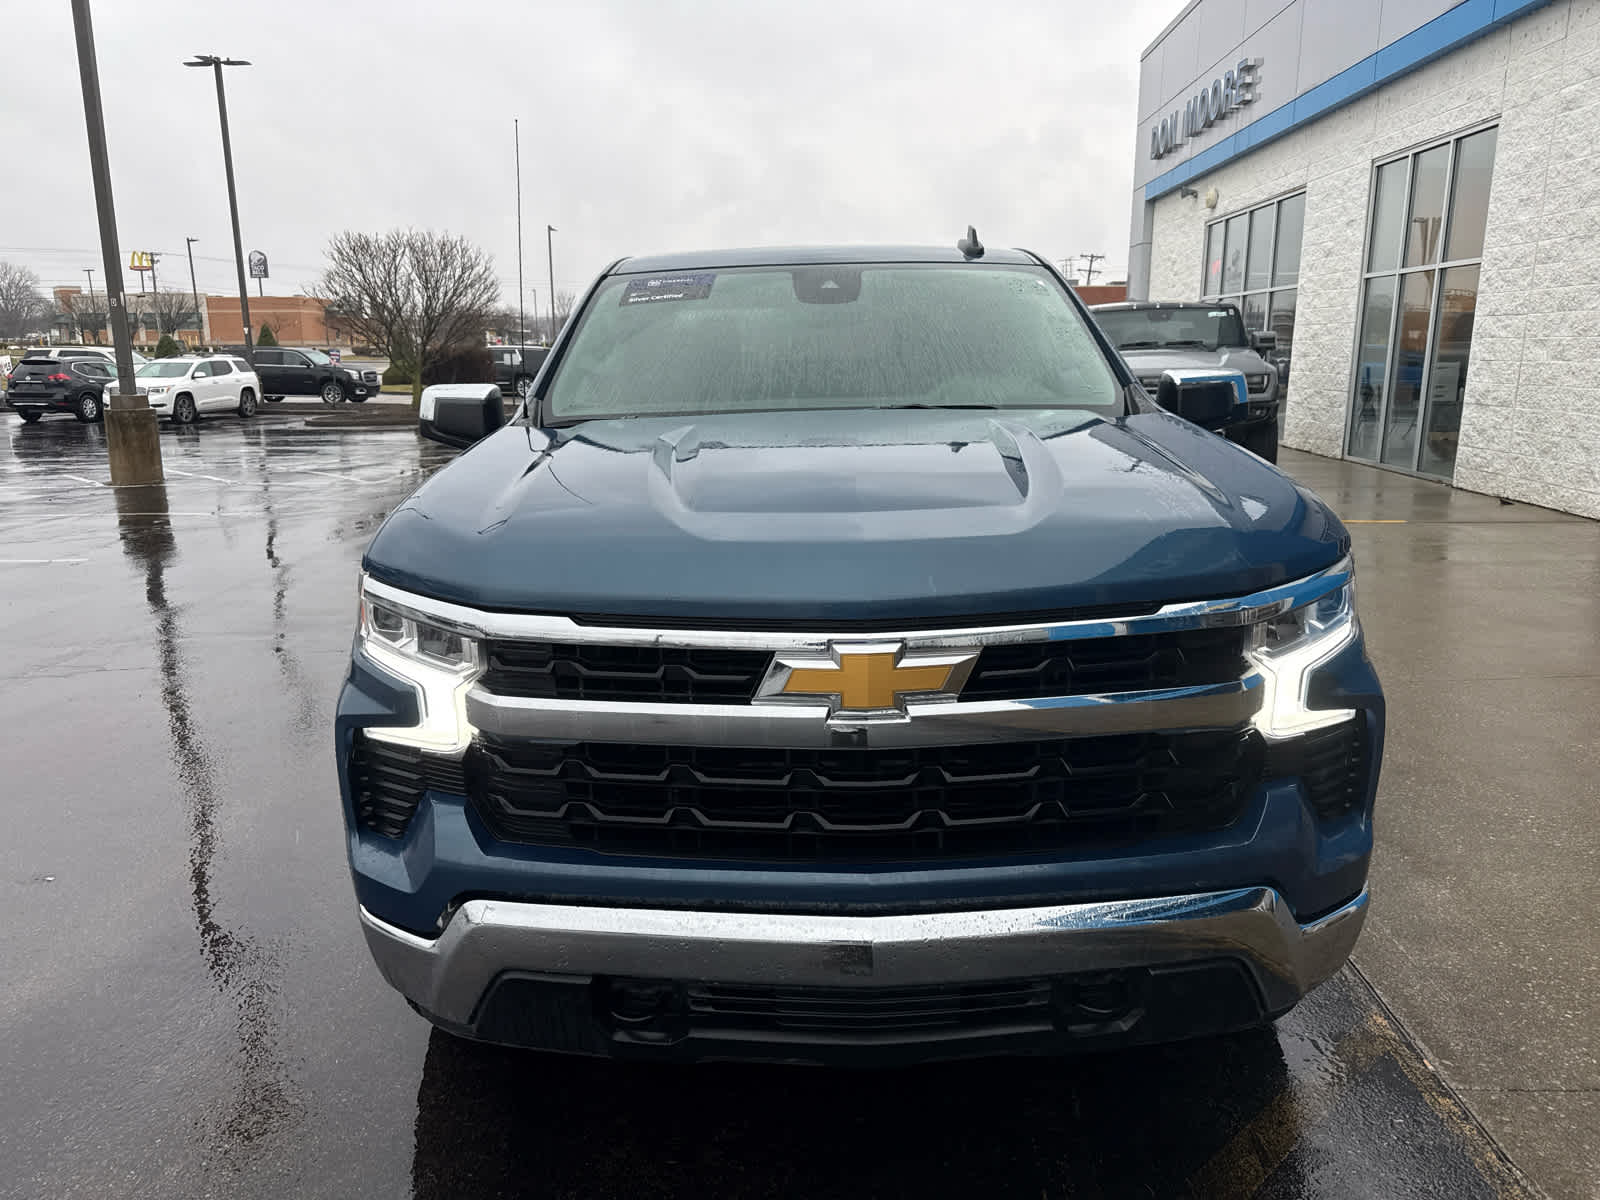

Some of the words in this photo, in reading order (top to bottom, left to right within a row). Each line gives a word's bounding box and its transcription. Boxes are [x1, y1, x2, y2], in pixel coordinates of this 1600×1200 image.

[1150, 110, 1182, 160] DON
[1182, 57, 1258, 138] MOORE
[651, 293, 683, 301] Certified
